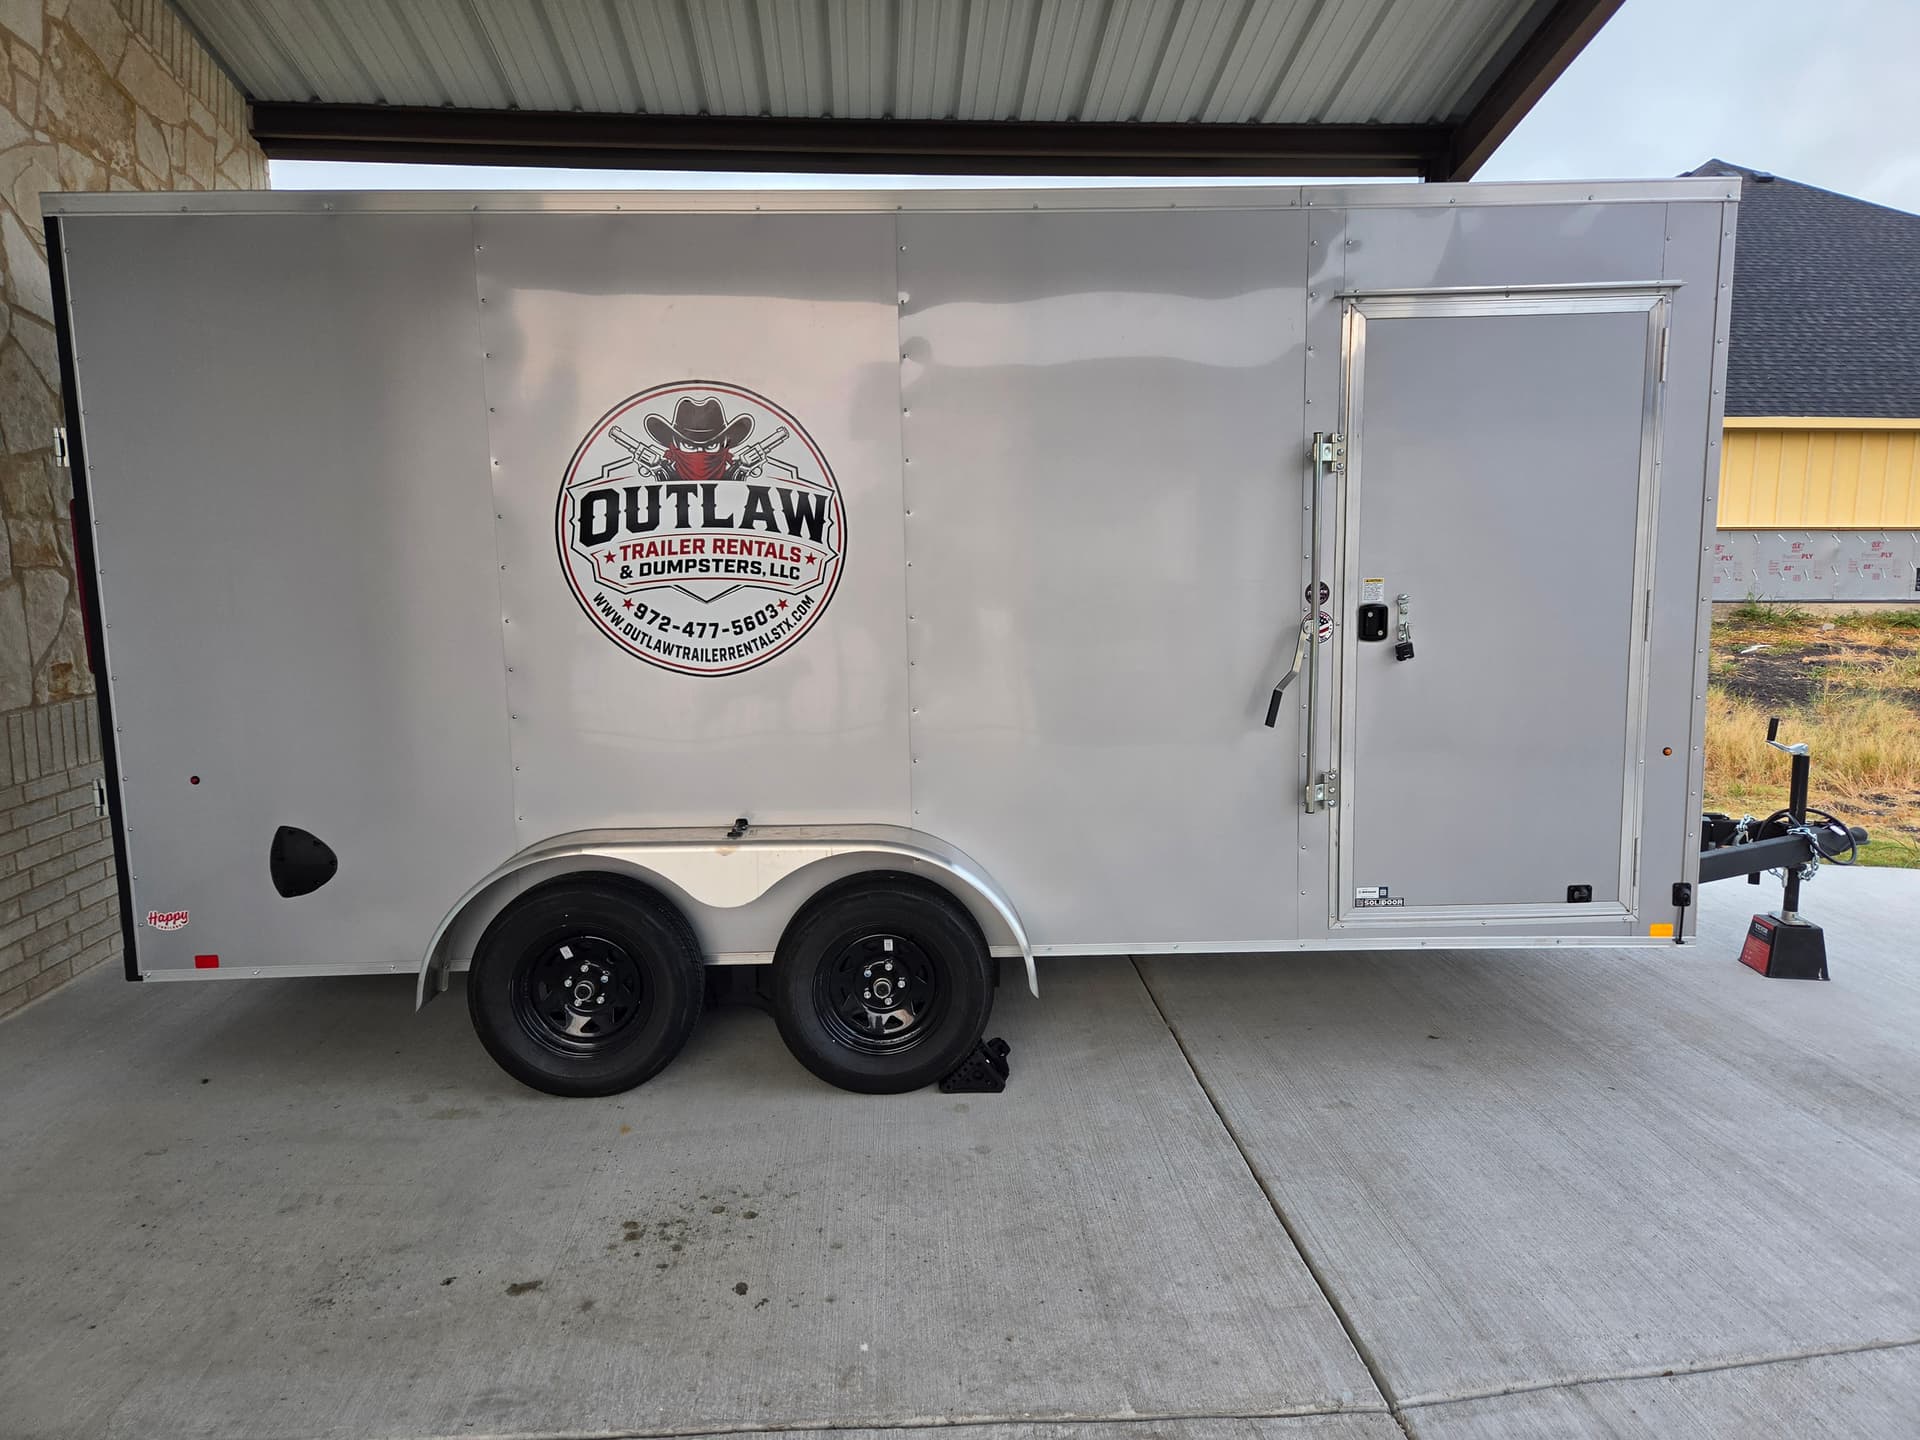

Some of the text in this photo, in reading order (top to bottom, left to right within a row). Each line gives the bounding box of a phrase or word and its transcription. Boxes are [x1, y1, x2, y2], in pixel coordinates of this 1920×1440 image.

[578, 483, 828, 547] OUTLAW
[619, 538, 802, 563] TRAILER RENTALS
[619, 565, 633, 579] &
[769, 562, 801, 580] LLC
[593, 592, 815, 662] WWW.OUTLAWTRAILERRENTALSTX.COM
[633, 602, 779, 639] 972-477-5603
[148, 911, 188, 926] Happy
